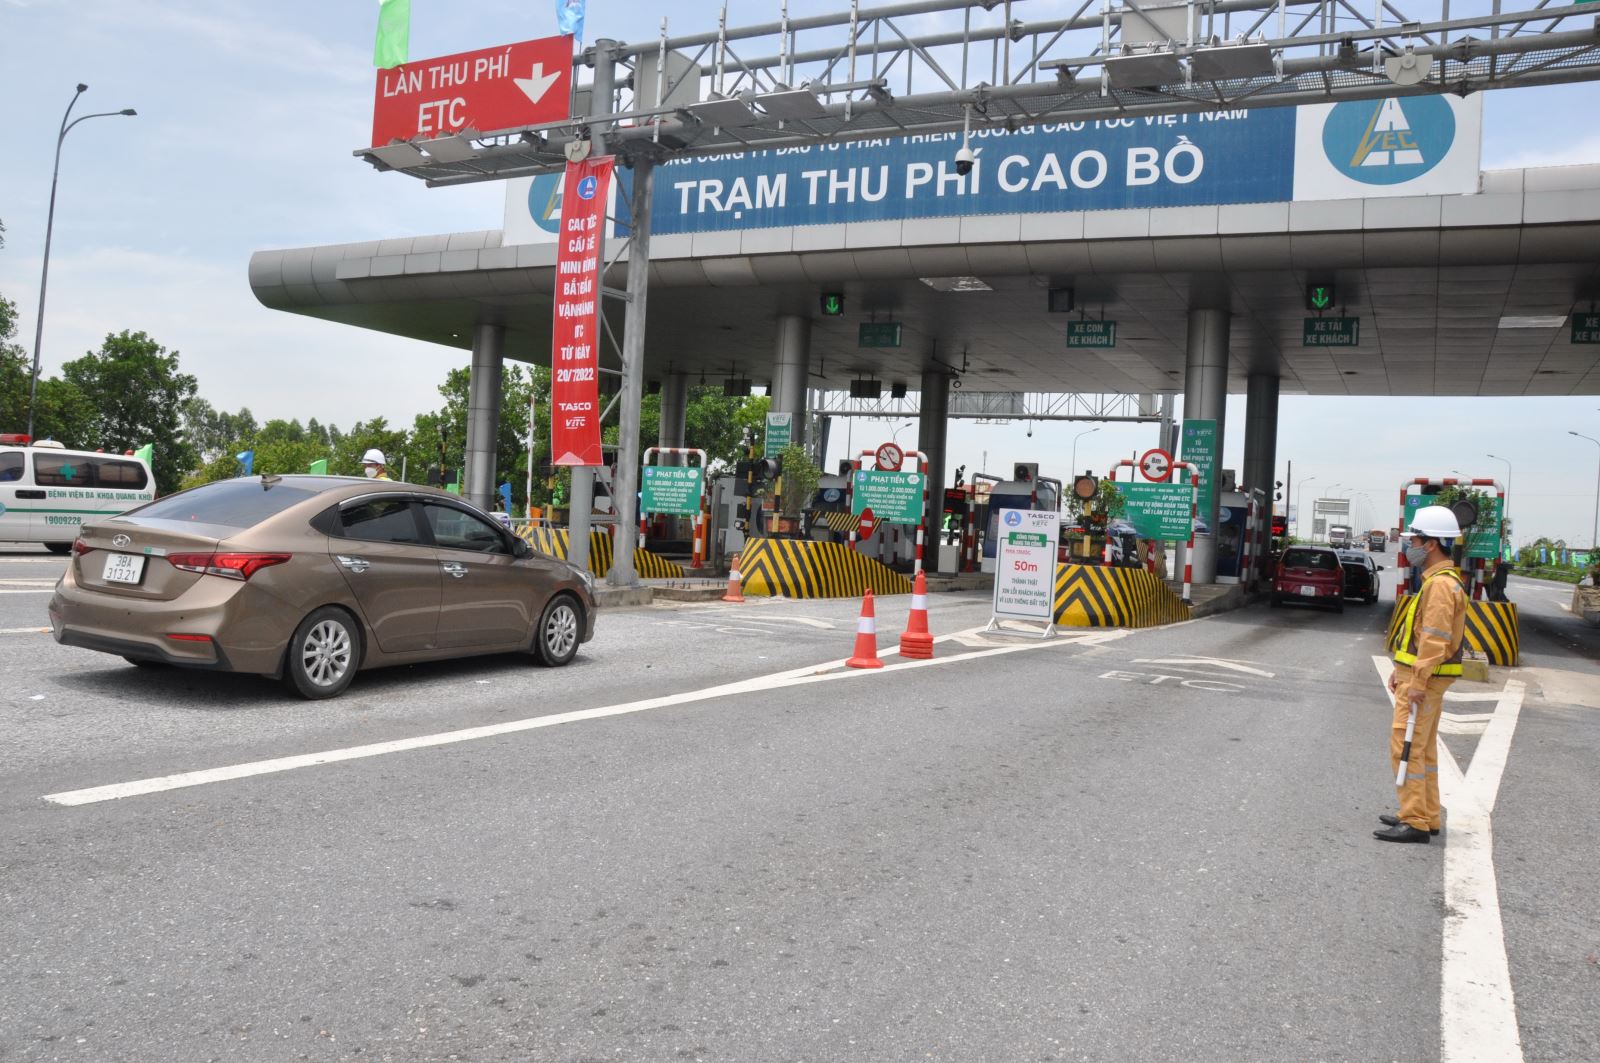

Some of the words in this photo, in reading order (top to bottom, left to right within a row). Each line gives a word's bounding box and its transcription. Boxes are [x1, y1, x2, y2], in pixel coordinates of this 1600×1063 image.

[384, 66, 422, 97] LÀN
[428, 61, 468, 89] THU
[474, 47, 512, 82] PHÍ
[418, 97, 466, 132] ETC
[1199, 109, 1248, 122] NAM
[674, 173, 787, 219] TRẠM
[802, 165, 888, 204] THU
[905, 148, 983, 199] PHÍ
[998, 149, 1107, 193] CAO
[1126, 135, 1204, 186] BỒ
[1074, 324, 1085, 332] XE
[1087, 324, 1103, 332] CON
[1070, 336, 1080, 344] XE
[1082, 334, 1107, 344] KHÁCH
[559, 402, 592, 411] TASCO
[871, 475, 888, 484] PHẠT
[890, 474, 905, 484] TIỀN
[45, 516, 81, 524] 19009228
[116, 556, 132, 568] 38A
[1014, 561, 1037, 572] 50m
[107, 568, 135, 581] 313.21
[1098, 670, 1246, 692] ETC
